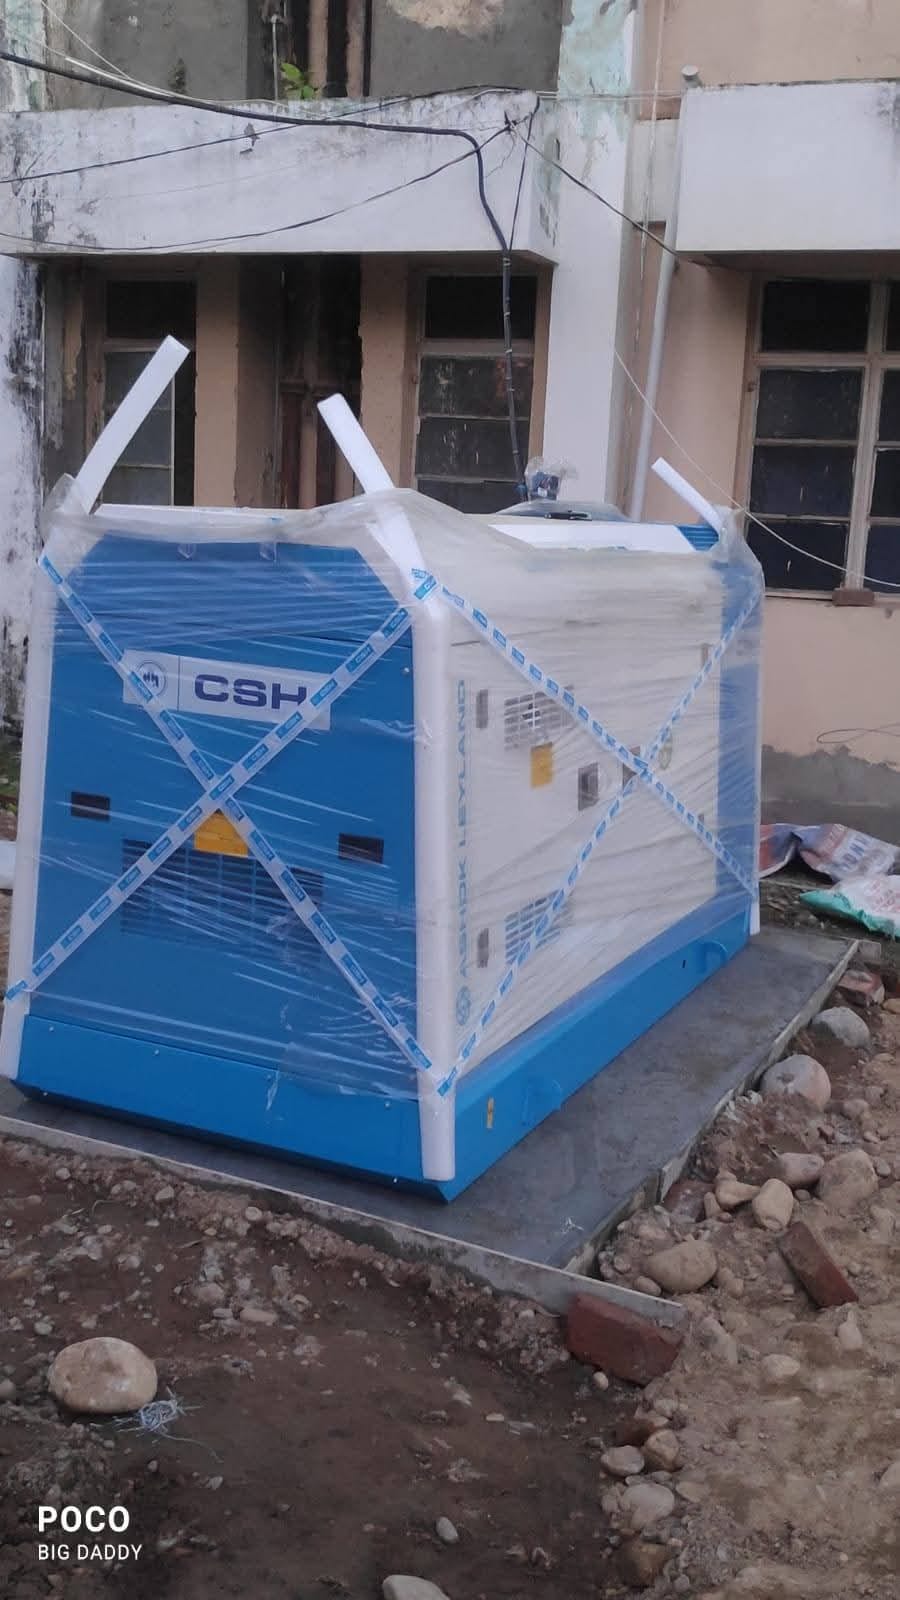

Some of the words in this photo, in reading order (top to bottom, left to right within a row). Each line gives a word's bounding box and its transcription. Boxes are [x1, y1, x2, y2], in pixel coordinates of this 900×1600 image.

[194, 674, 307, 710] CSH
[457, 679, 467, 847] LEYLAND
[458, 855, 468, 978] ASHOK
